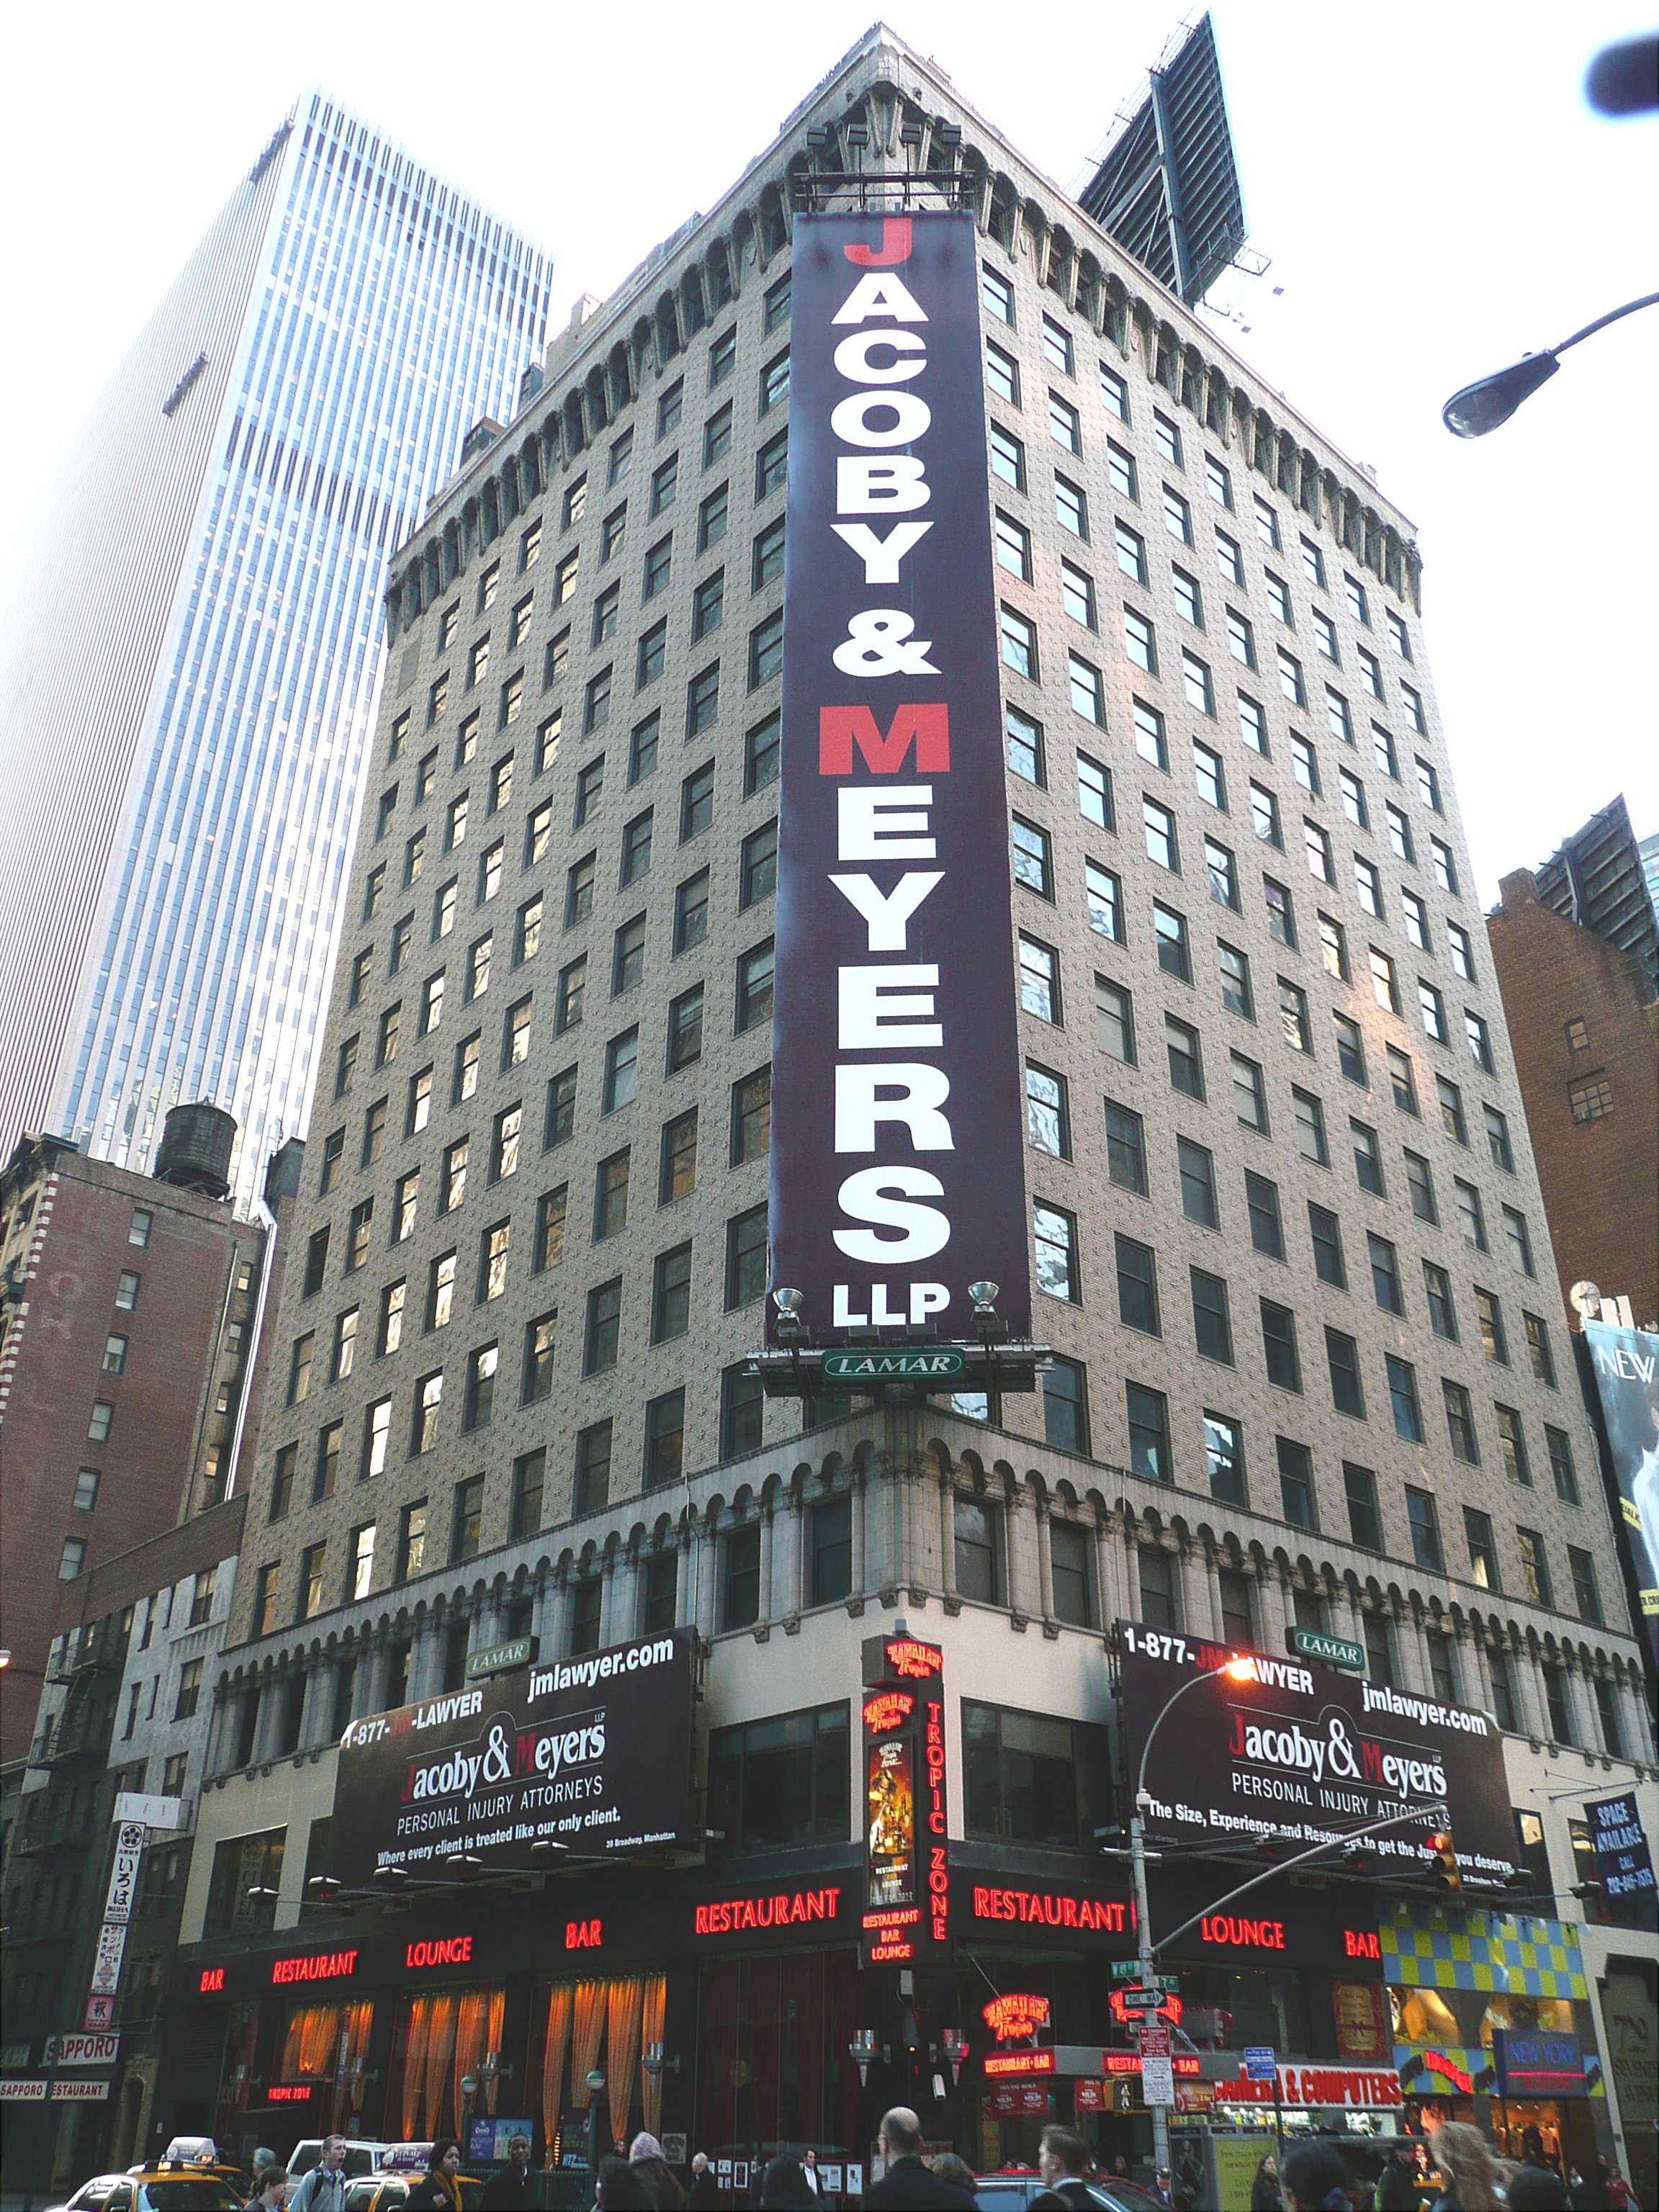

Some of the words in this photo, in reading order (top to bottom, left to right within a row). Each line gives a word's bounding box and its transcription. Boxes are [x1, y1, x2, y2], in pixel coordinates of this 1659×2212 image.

[830, 218, 934, 584] JACOBY
[832, 608, 942, 677] &
[819, 703, 955, 1264] MEYERS
[833, 1282, 950, 1327] LLP
[838, 1357, 951, 1373] LAMAR
[1596, 1345, 1655, 1383] NEW
[472, 1643, 523, 1671] LAMAR
[1303, 1635, 1357, 1663] LAMAR
[528, 1637, 673, 1703] jmlawyer.com
[896, 1658, 932, 1678] Tropic
[595, 1712, 605, 1722] LLP
[871, 1712, 902, 1733] Tropic
[1362, 1681, 1488, 1736] jmlawyer.com
[400, 1750, 482, 1802] Jacoby
[483, 1725, 511, 1782] &
[515, 1724, 606, 1779] Meyers
[926, 1701, 945, 1834] TROPIC
[1228, 1713, 1326, 1782] Jacoby
[1328, 1718, 1362, 1779] &
[1361, 1740, 1448, 1799] Meyers
[397, 1807, 460, 1835] PERSONAL
[467, 1794, 514, 1821] INJURY
[520, 1775, 603, 1810] ATTORNEYS
[1231, 1772, 1313, 1806] PERSONAL
[1320, 1789, 1369, 1815] INJURY
[1597, 1802, 1629, 1827] SPACE
[378, 1850, 405, 1866] Where
[408, 1843, 433, 1860] every
[435, 1838, 462, 1856] client
[465, 1836, 473, 1849] is
[476, 1829, 512, 1847] treated
[516, 1824, 534, 1838] like
[537, 1820, 555, 1835] our
[559, 1813, 582, 1832] only
[585, 1807, 621, 1826] client.
[644, 1832, 675, 1843] Manhattan
[1149, 1799, 1173, 1819] The
[1176, 1804, 1207, 1827] Size,
[1210, 1809, 1277, 1834] Experience
[1281, 1822, 1302, 1839] and
[1364, 1835, 1376, 1850] to
[1378, 1839, 1396, 1856] get
[1397, 1840, 1415, 1856] the
[1455, 1853, 1473, 1867] you
[113, 1857, 133, 1906] いろは
[875, 1863, 909, 1875] RESTAURANT
[881, 1879, 903, 1889] LOUNGE
[930, 1847, 948, 1940] ZONE
[696, 1888, 841, 1934] RESTAURANT
[863, 1910, 919, 1928] RESTAURANT
[974, 1886, 1126, 1933] RESTAURANT
[566, 1919, 602, 1948] BAR
[881, 1929, 900, 1943] BAR
[1202, 1914, 1286, 1949] LOUNGE
[1345, 1930, 1380, 1959] BAR
[407, 1936, 472, 1967] LOUNGE
[871, 1944, 911, 1960] LOUNGE
[200, 1969, 225, 1992] BAR
[272, 1950, 358, 1984] RESTAURANT
[984, 1995, 1049, 2027] HAWAIIAN
[1128, 1995, 1141, 2004] ONE
[1146, 1994, 1160, 2002] WAY
[994, 2017, 1033, 2041] Tropic
[985, 2056, 1030, 2073] RESTAURANT
[1034, 2055, 1050, 2069] BAR
[1178, 2059, 1200, 2073] BAR
[1509, 2040, 1539, 2064] NEW
[1544, 2040, 1578, 2065] YORK
[1, 2085, 42, 2096] SAPPORO
[268, 2087, 292, 2100] TROPIC
[1286, 2068, 1300, 2103] &
[1300, 2068, 1403, 2105] COMPUTERS
